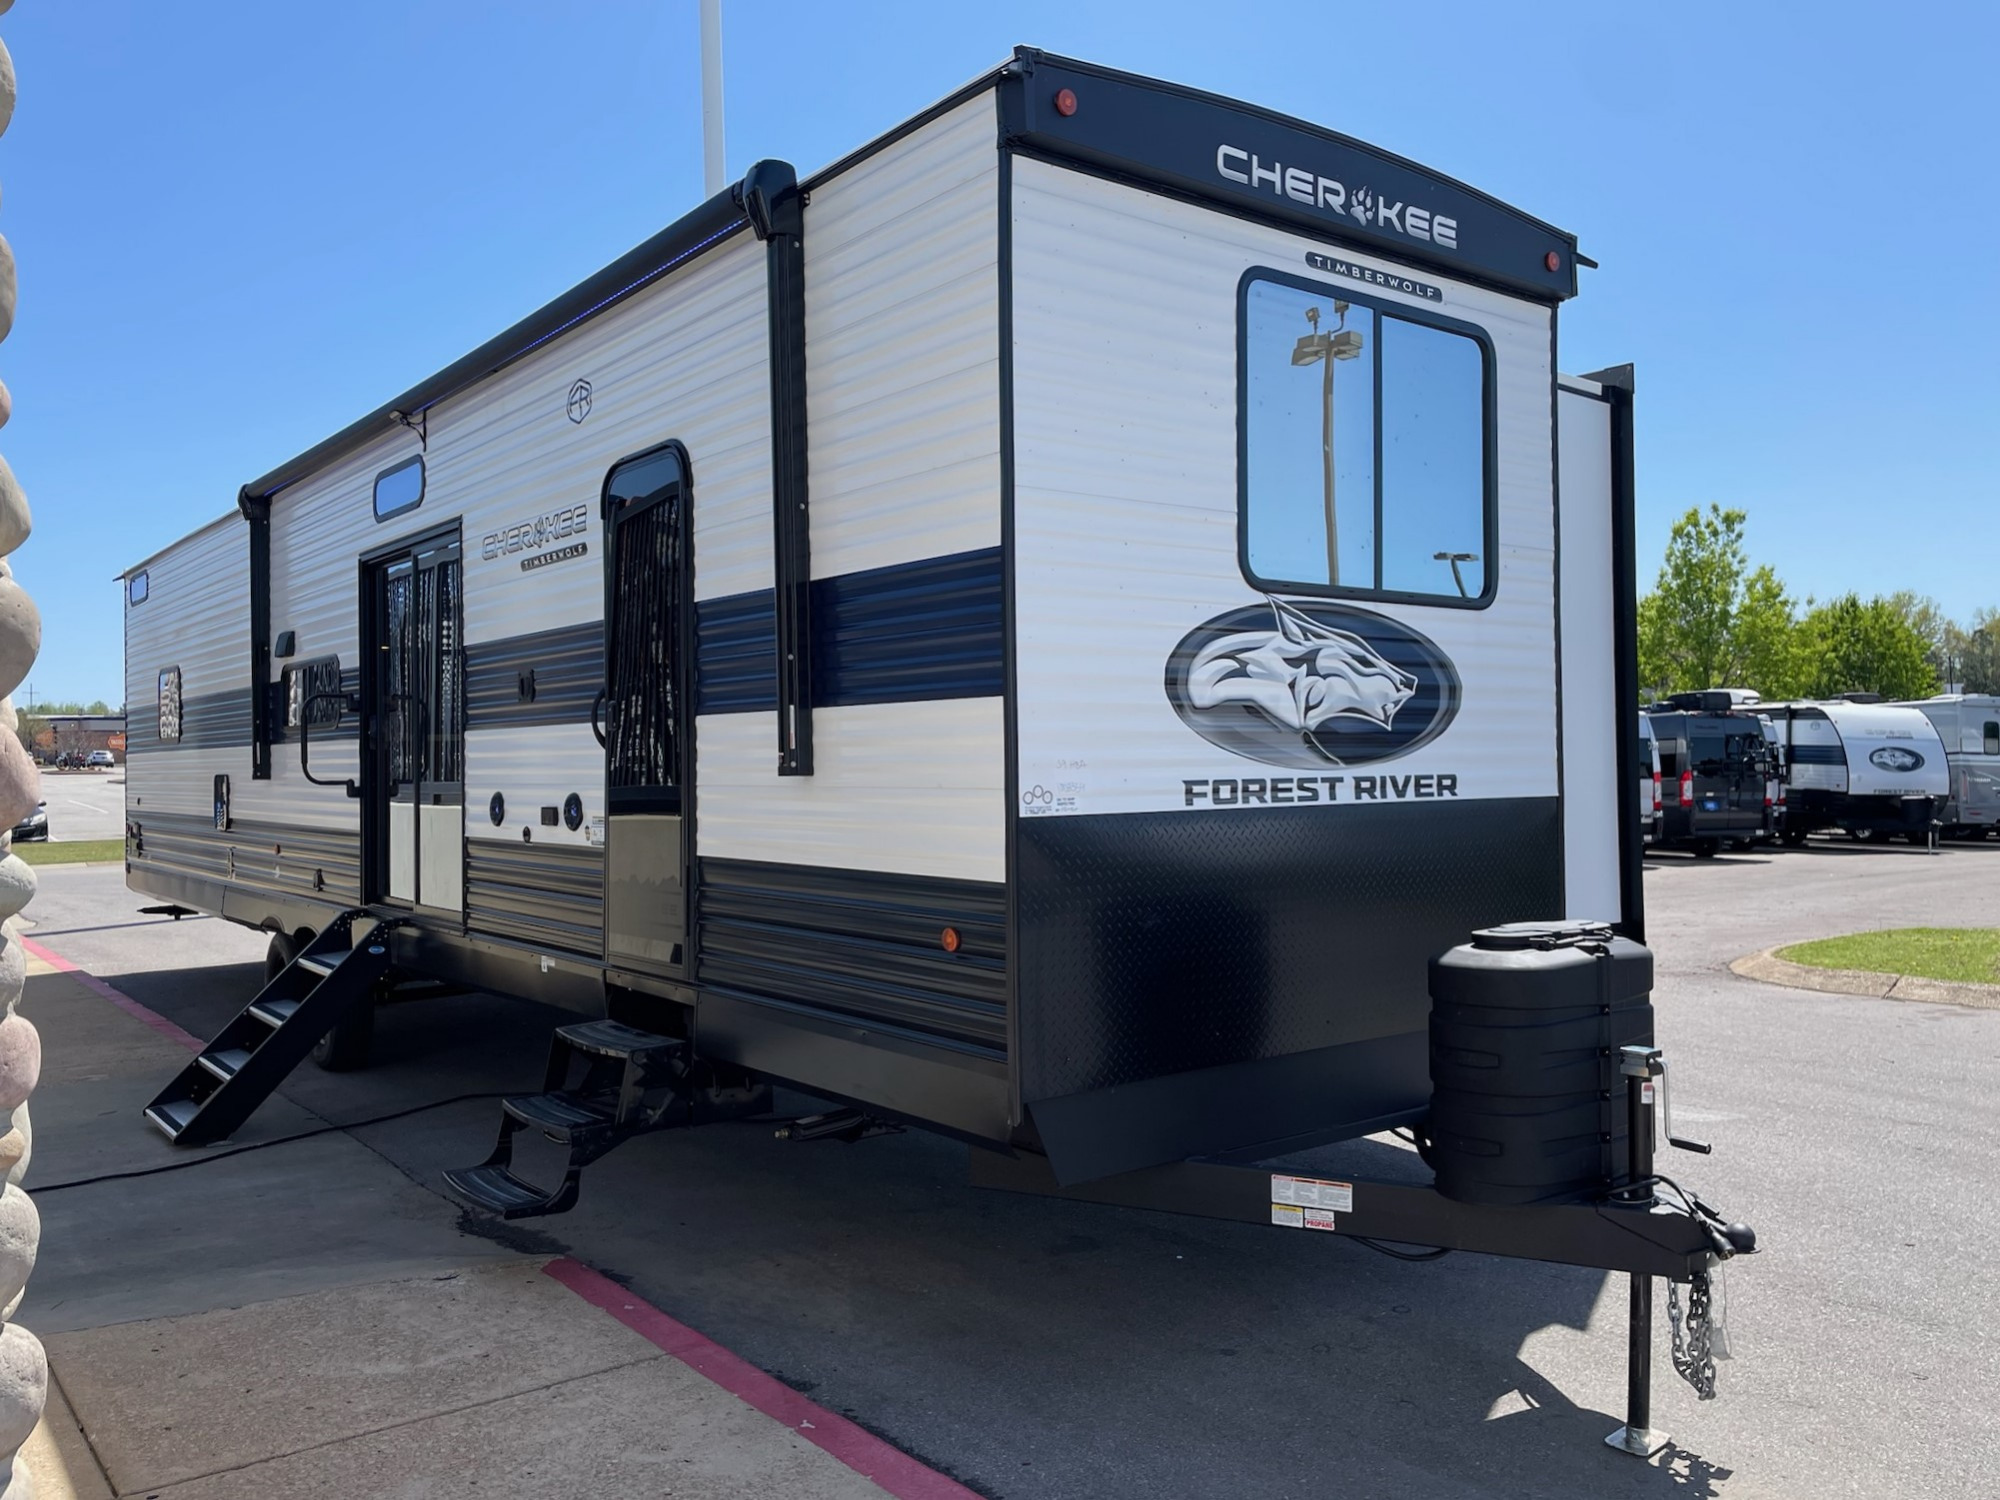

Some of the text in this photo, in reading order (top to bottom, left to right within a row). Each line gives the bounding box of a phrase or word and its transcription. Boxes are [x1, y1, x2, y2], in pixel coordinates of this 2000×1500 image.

[1314, 255, 1435, 299] TIMBERWOLF
[522, 546, 585, 568] TIMBERWOLF
[1181, 773, 1459, 806] FOREST RIVER
